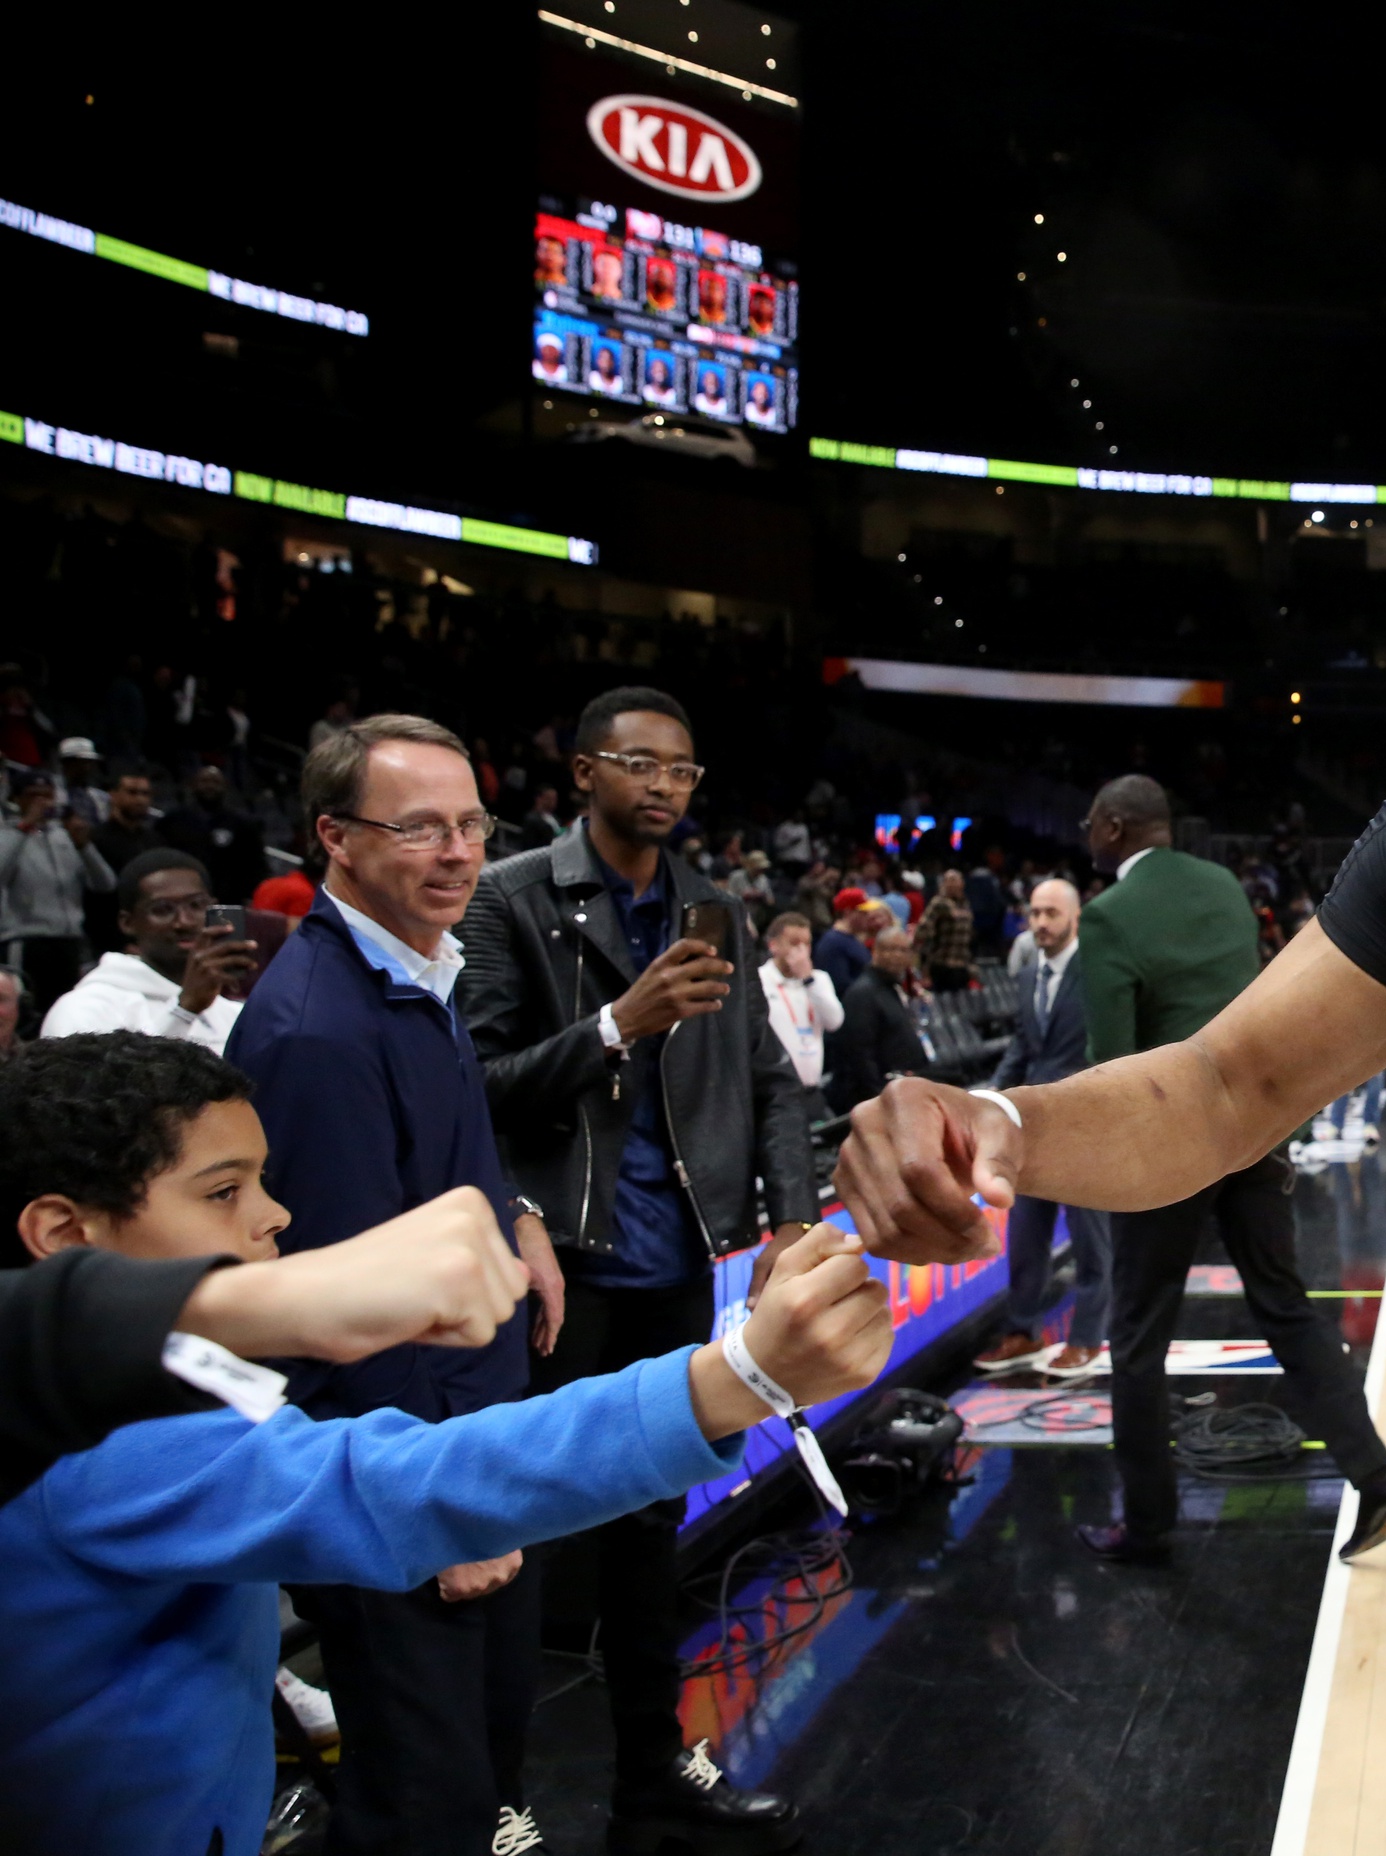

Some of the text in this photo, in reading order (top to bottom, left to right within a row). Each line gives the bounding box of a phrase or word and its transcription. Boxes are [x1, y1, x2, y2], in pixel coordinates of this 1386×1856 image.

[619, 107, 736, 191] KIA
[25, 417, 55, 454] WE
[56, 428, 115, 468] BREW
[115, 442, 165, 479] BEER
[165, 455, 203, 488] FOR
